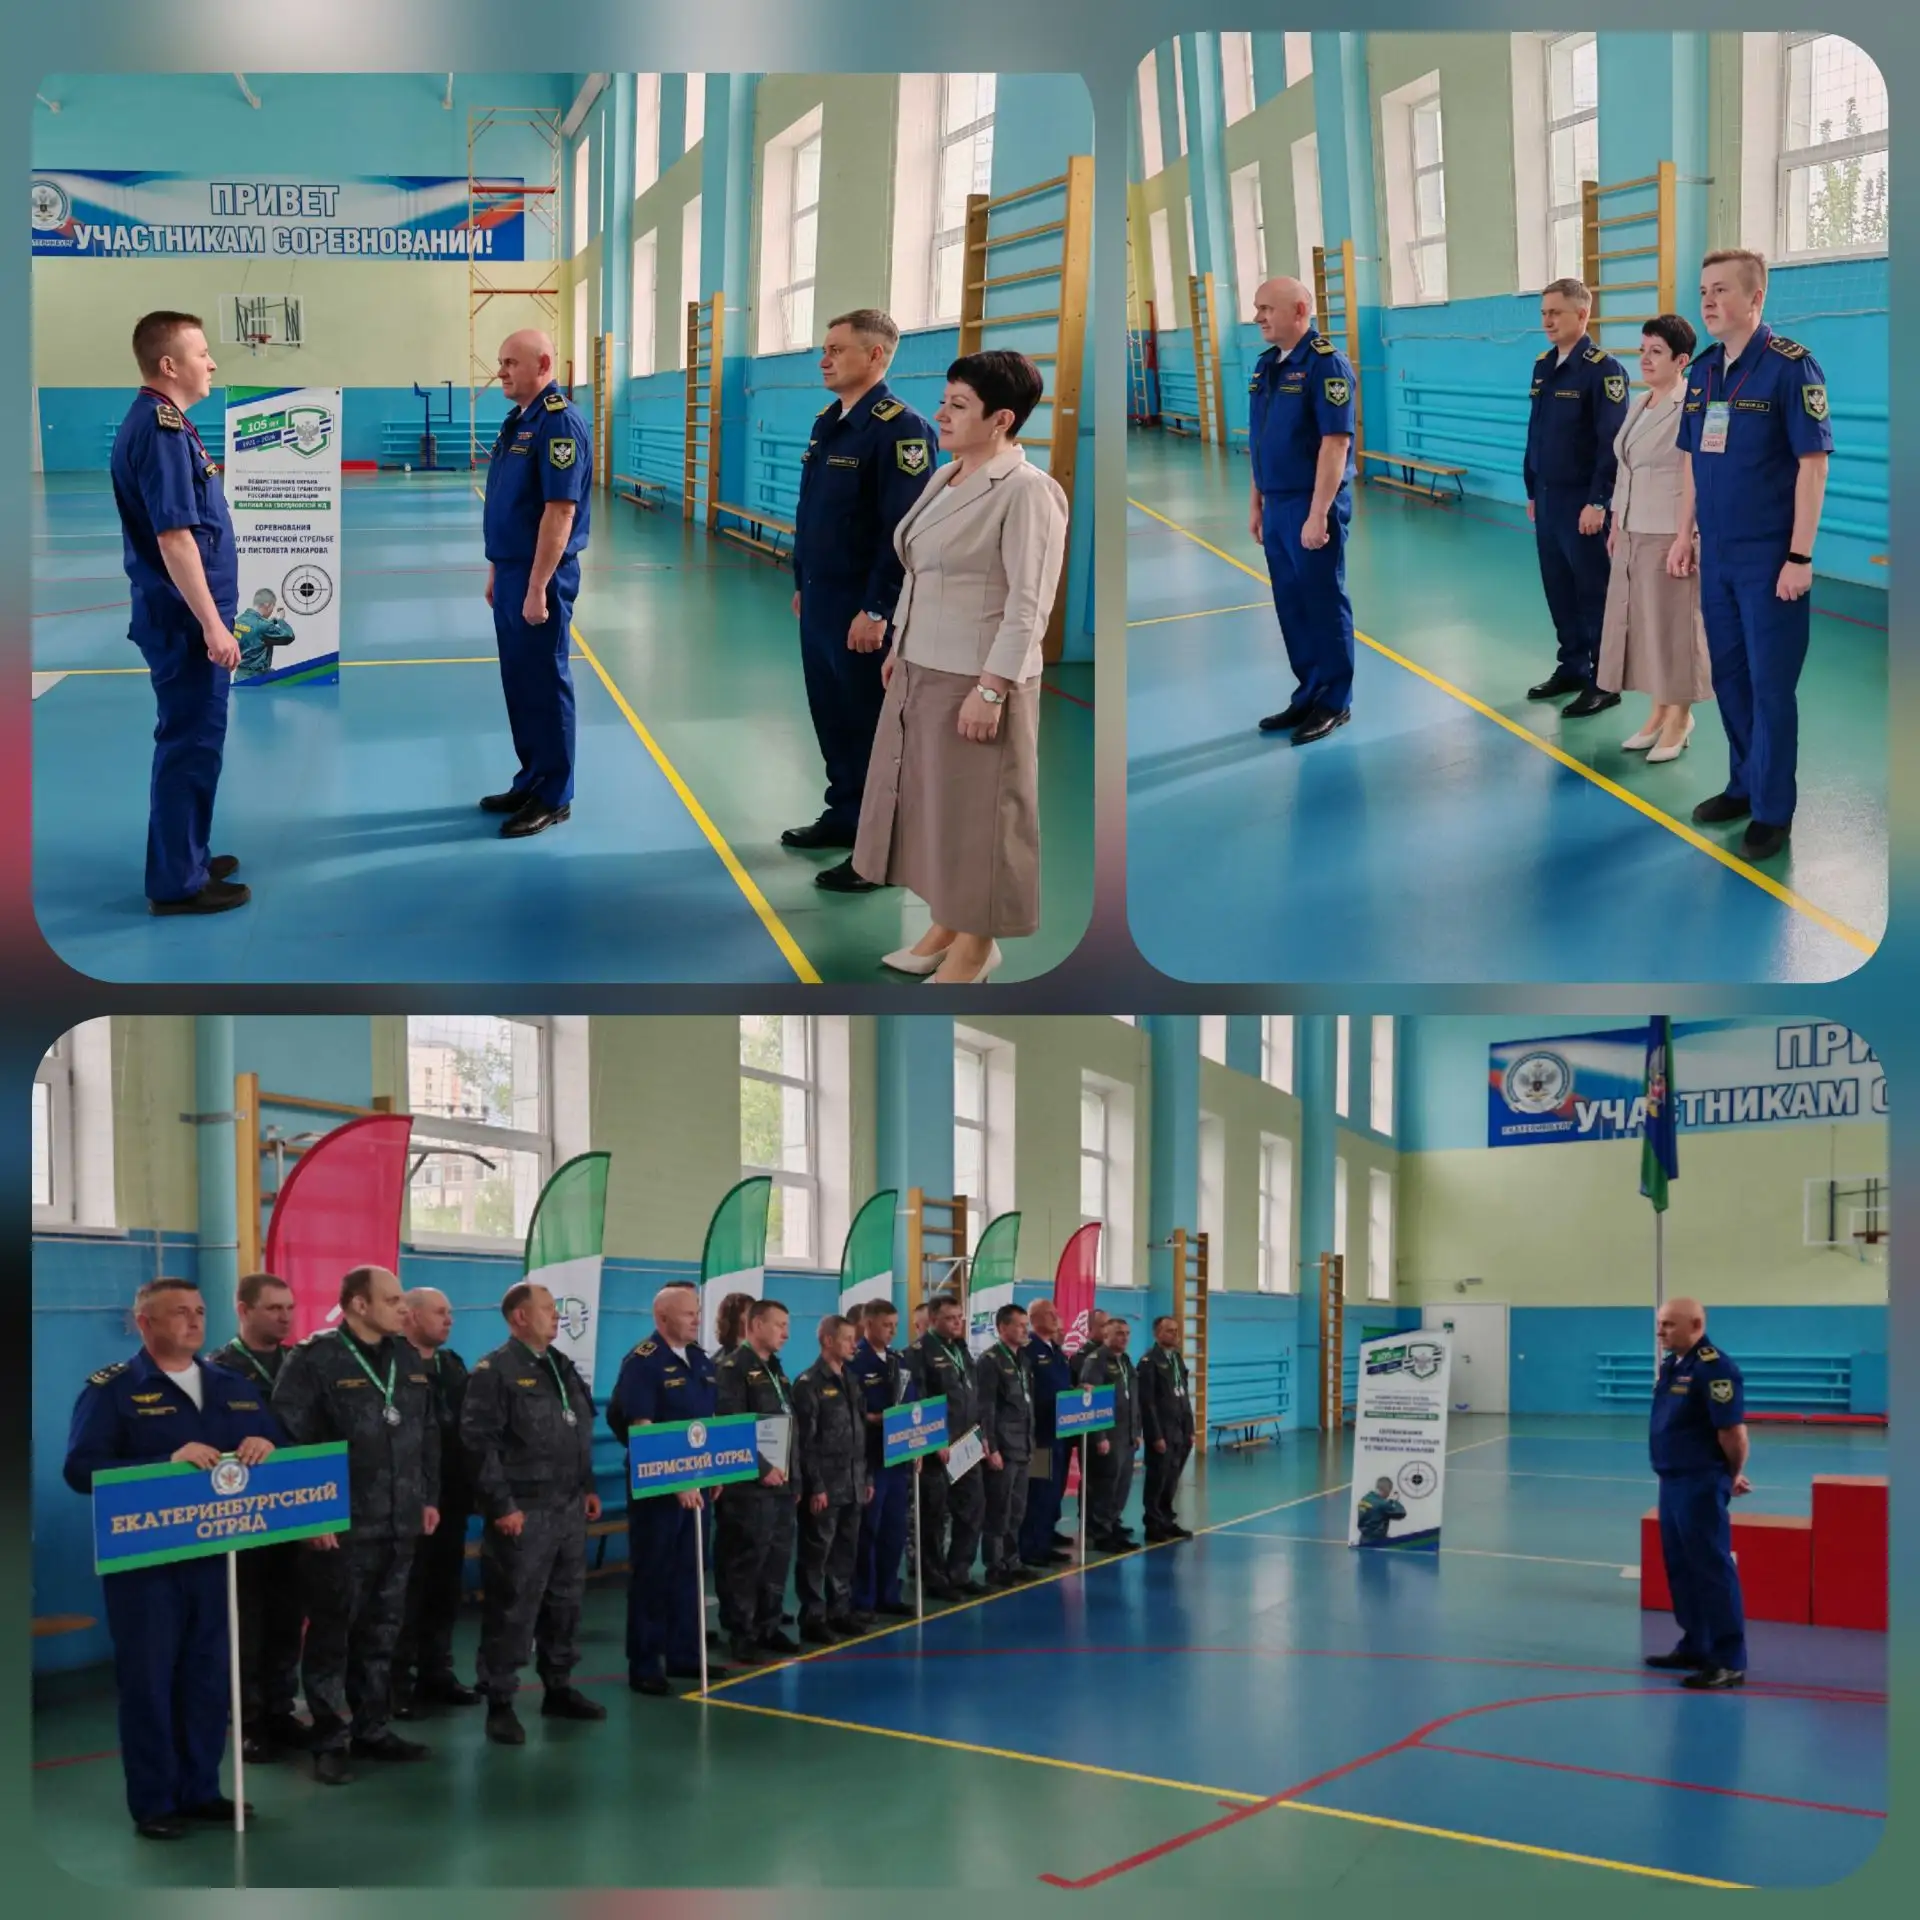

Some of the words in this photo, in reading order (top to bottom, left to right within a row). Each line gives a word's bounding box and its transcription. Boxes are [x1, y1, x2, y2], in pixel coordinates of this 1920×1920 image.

[210, 183, 340, 217] ПРИВЕТ
[73, 224, 265, 254] УЧАСТНИКАМ
[272, 224, 493, 255] СОРЕВНОВАНИЙ!
[247, 419, 267, 433] 105
[242, 533, 298, 543] ПРАКТИЧЕСКОЙ
[1575, 1078, 1859, 1133] УЧАТНИКАМ
[638, 1452, 713, 1478] ПЕРМСКИЙ
[715, 1448, 754, 1466] ОТРЯД
[110, 1481, 338, 1534] ЕКАТЕРИНБУРГСКИЙ
[196, 1513, 267, 1539] ОТРЯД
